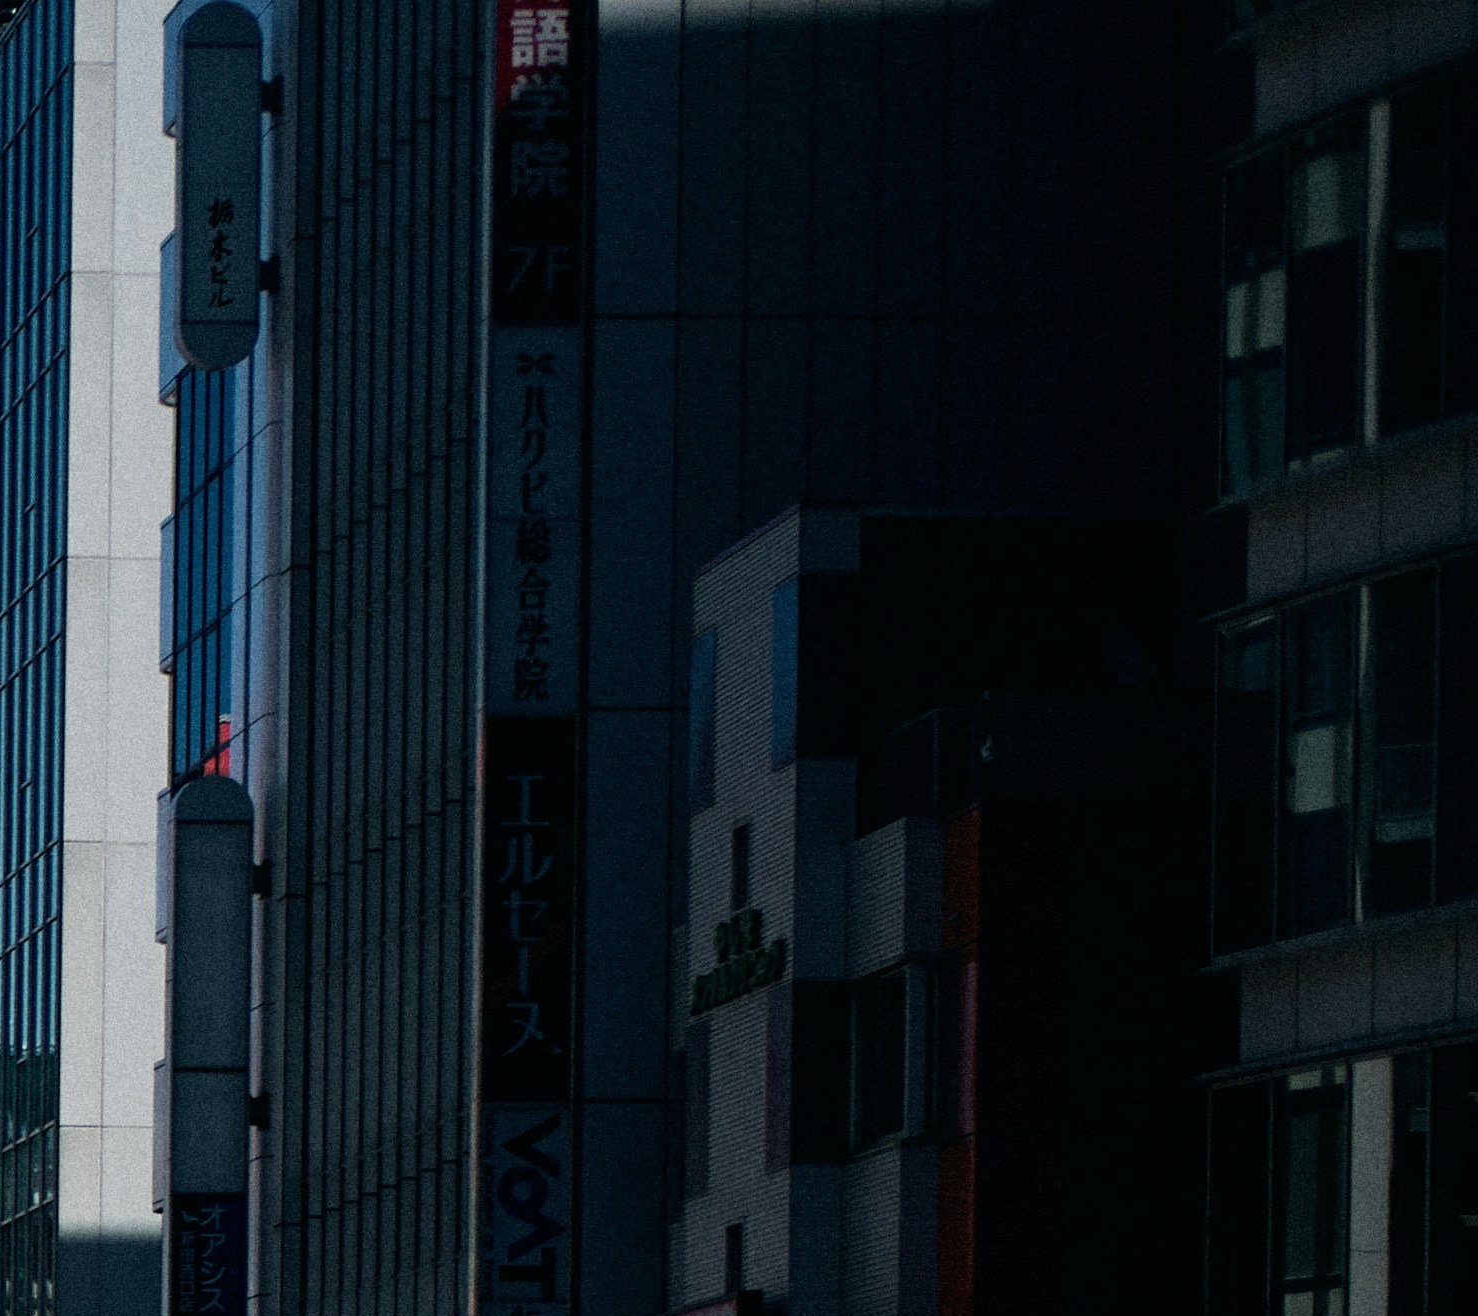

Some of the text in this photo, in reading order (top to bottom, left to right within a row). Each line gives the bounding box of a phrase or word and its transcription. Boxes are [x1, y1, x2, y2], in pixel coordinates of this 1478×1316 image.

[508, 6, 571, 199] 語学院
[509, 244, 571, 293] 7F
[514, 384, 552, 702] ハクビ総合学院
[498, 773, 556, 1059] エルセーヌ
[200, 1202, 228, 1313] オアシス
